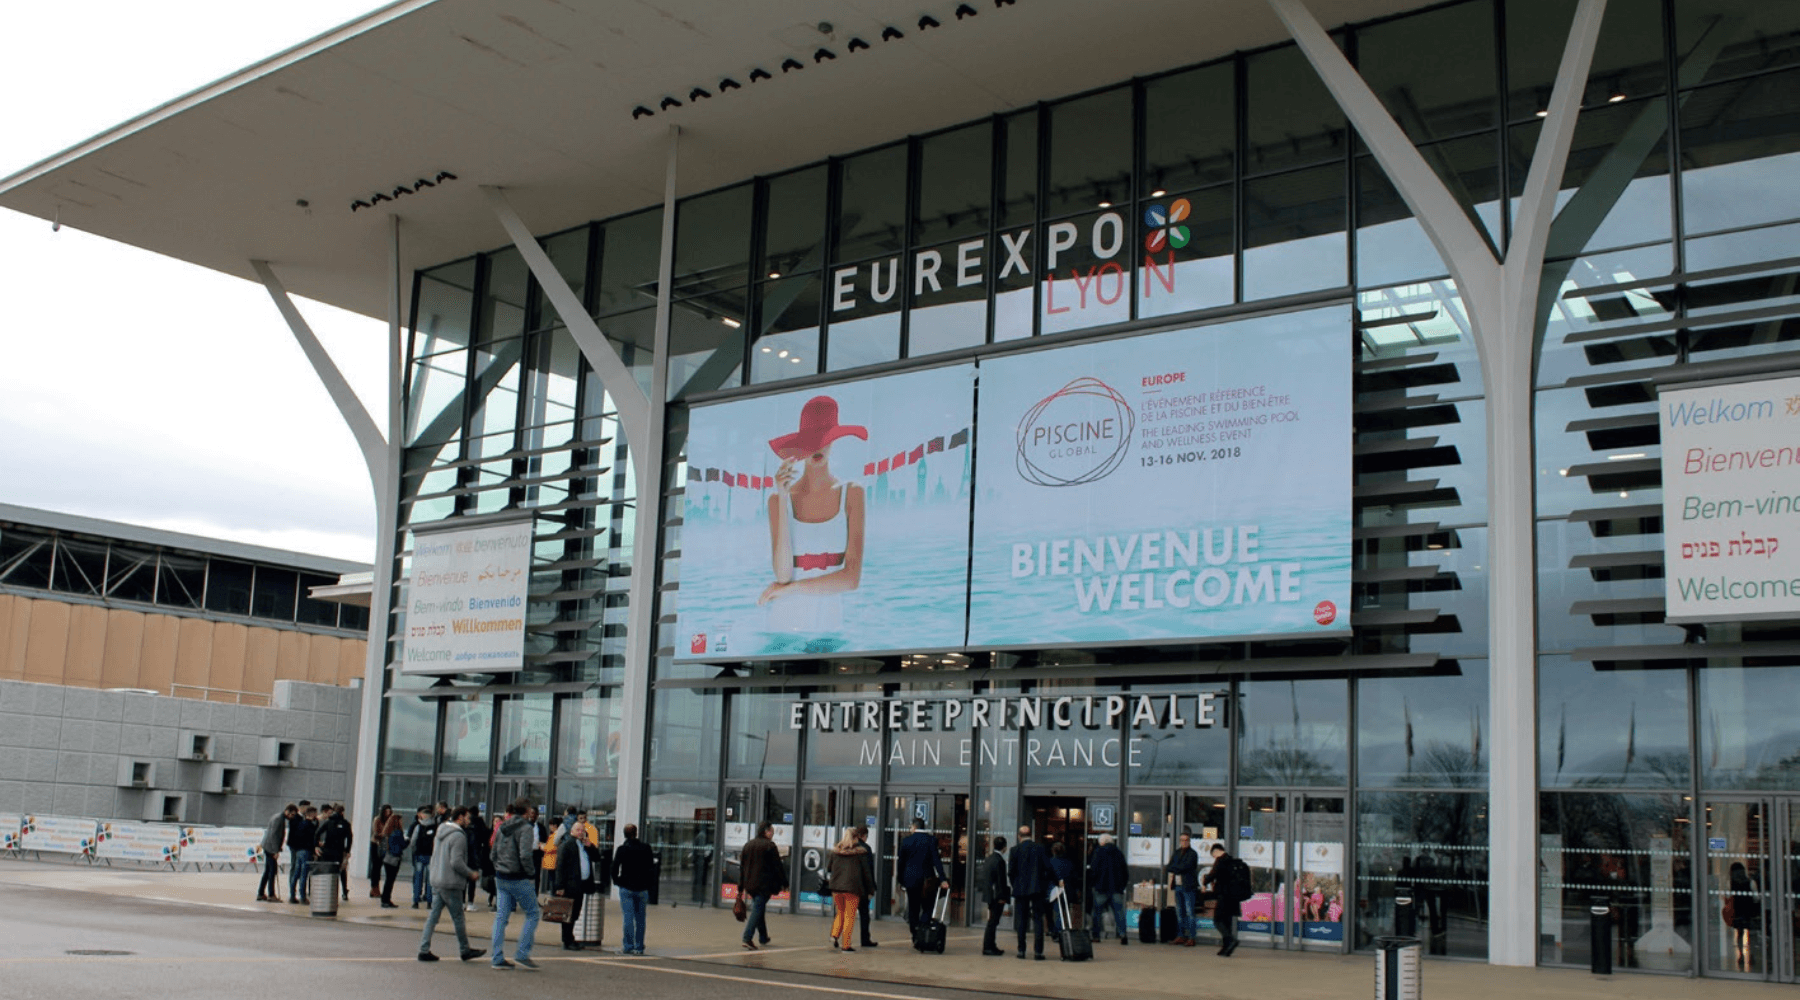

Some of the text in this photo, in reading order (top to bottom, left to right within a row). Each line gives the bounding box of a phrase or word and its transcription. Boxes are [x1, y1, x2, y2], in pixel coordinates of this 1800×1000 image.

[833, 212, 1123, 311] EUREXPO
[1046, 251, 1176, 314] LYON
[1142, 372, 1186, 387] EUROPE
[1209, 386, 1265, 402] RÉFÉRENCE
[1141, 411, 1153, 422] DE
[1156, 410, 1167, 420] LA
[1170, 405, 1207, 418] PISCINE
[1211, 403, 1221, 414] ET
[1224, 401, 1239, 412] DU
[1669, 399, 1773, 428] Welkom
[1033, 418, 1114, 446] PISCINE
[1141, 410, 1300, 438] THE LEADING SWIMMING POOL
[1141, 428, 1252, 449] AND WELLNESS EVENT
[1049, 445, 1097, 459] GLOBAL
[1141, 446, 1241, 467] 13-16 NOV. 2018
[1011, 525, 1260, 578] BIENVENUE
[1681, 540, 1720, 559] פנים
[1075, 563, 1301, 613] WELCOME
[469, 595, 521, 610] Bienvenido
[452, 618, 522, 635] Willkommen
[408, 647, 451, 662] Welcome
[944, 692, 1217, 729] PRINCIPALE
[859, 737, 1143, 767] MAIN ENTRANCE
